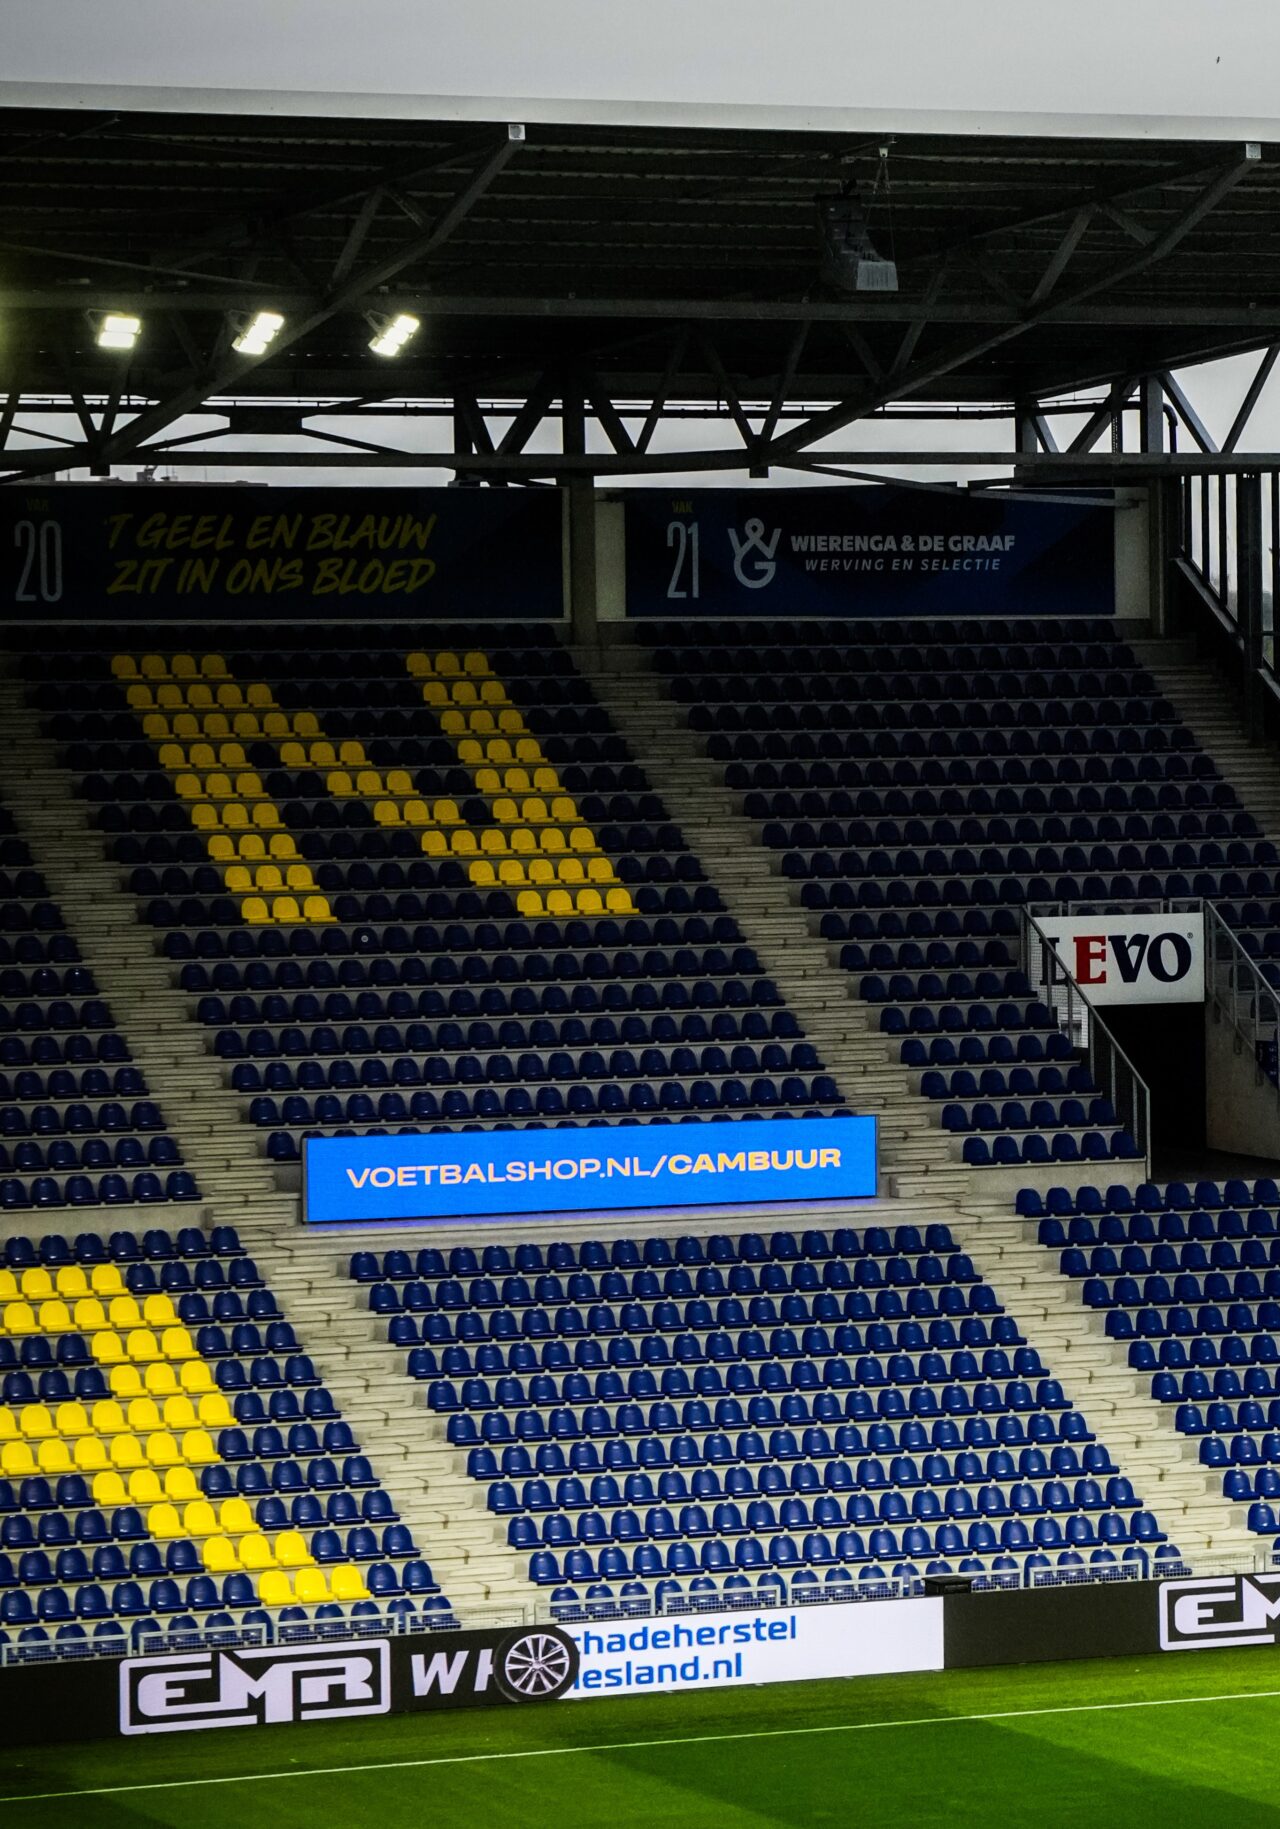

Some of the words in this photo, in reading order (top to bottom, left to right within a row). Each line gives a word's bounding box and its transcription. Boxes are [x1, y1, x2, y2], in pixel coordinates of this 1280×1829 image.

[136, 511, 235, 551] GEEL
[245, 513, 303, 551] EN
[305, 513, 438, 551] BLAUW
[790, 535, 898, 552] WIERENGA
[901, 535, 916, 552] &
[918, 535, 946, 552] DE
[948, 534, 1016, 552] GRAAF
[14, 519, 64, 603] 20
[106, 558, 175, 596] ZIT
[176, 557, 220, 594] IN
[225, 557, 305, 595] ONS
[311, 557, 438, 596] BLOED
[666, 521, 700, 599] 21
[805, 558, 884, 572] WERVING
[892, 558, 914, 571] EN
[921, 558, 1002, 571] SELECTIE
[346, 1148, 841, 1189] VOETBALSHOP.NL/CAMBUUR
[136, 1648, 374, 1724] EMR
